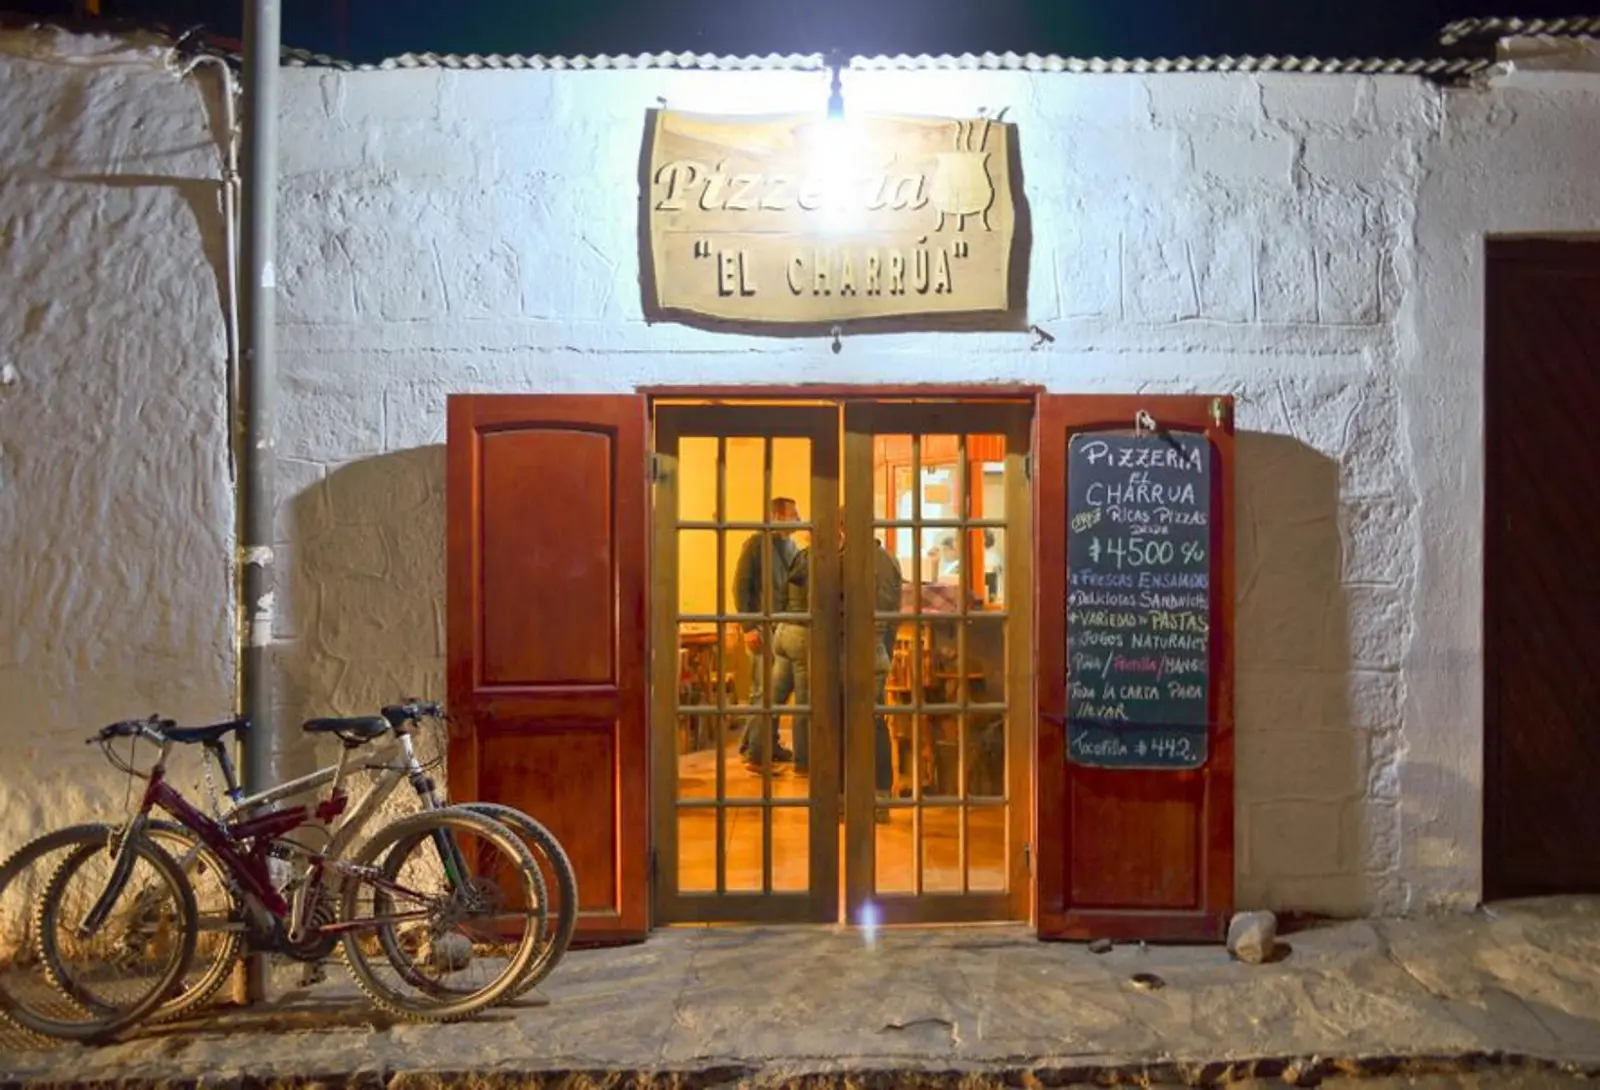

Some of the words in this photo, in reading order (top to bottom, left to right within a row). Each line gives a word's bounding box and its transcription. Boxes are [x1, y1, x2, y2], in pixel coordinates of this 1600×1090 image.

[1086, 481, 1195, 506] CHARRUA
[1106, 504, 1150, 523] RICAS
[1153, 506, 1207, 525] PIZZAS
[1150, 609, 1209, 633] PASTAS
